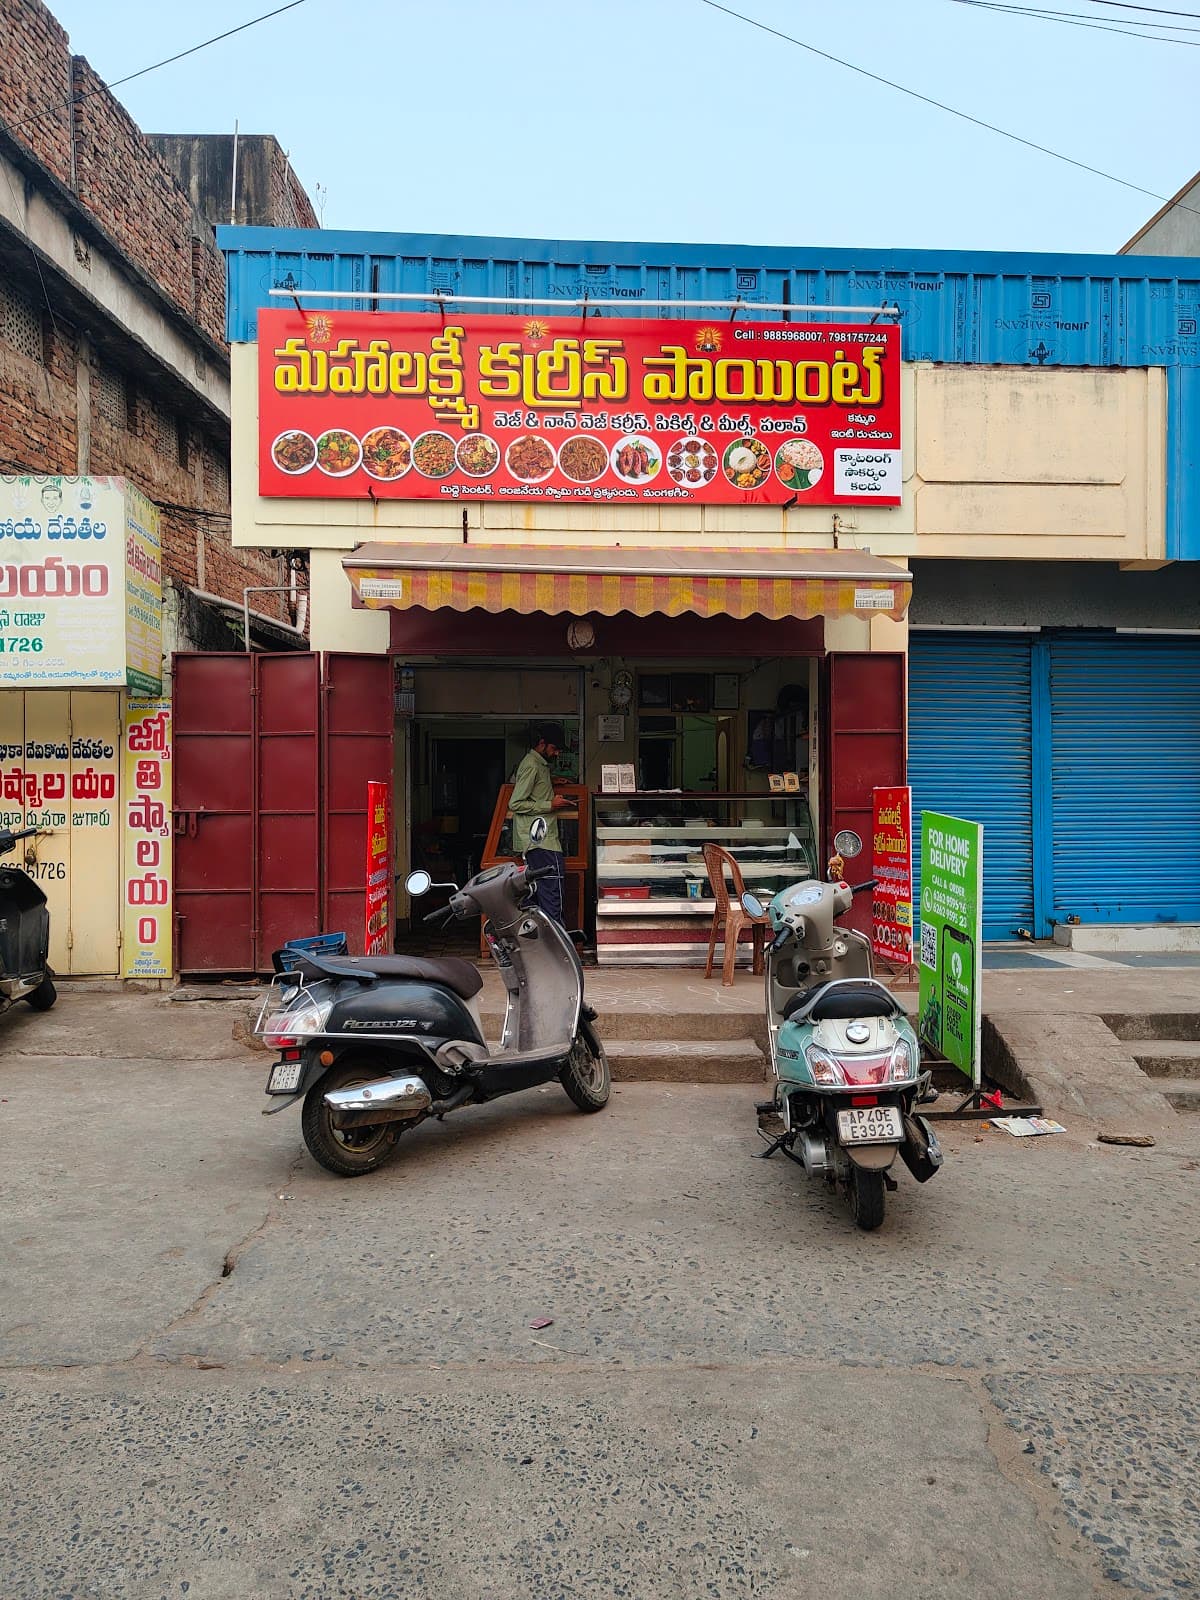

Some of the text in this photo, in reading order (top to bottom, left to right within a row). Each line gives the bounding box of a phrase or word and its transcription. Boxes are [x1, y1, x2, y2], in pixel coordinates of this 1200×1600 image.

[734, 329, 755, 341] Cell
[828, 332, 888, 344] 7981757244
[274, 326, 885, 430] మహాలక్ష్మీ కర్రీస్ పాయింట్
[493, 410, 522, 428] వెజ్
[525, 413, 540, 428] &
[544, 412, 577, 429] నాన్
[581, 411, 608, 430] వెజ్
[655, 414, 698, 435] పికిల్స్
[700, 416, 715, 431] &
[760, 416, 808, 434] పలావ్
[847, 413, 876, 426] కమ్మని
[831, 428, 893, 440] ఇంటి రుచులు
[839, 452, 892, 467] క్యాటరింగ్
[545, 487, 572, 499] స్వామి
[574, 487, 592, 497] గుడి
[850, 481, 882, 492] కలదు
[47, 514, 107, 541] దేవతల
[14, 611, 46, 628] రాజు
[72, 737, 114, 760] దేవతల
[72, 767, 115, 799] యం
[928, 827, 970, 859] FOR HOME
[930, 847, 968, 878] DELIVERY
[931, 874, 943, 889] CALL
[949, 882, 965, 898] ORDER
[851, 1123, 895, 1139] E3923
